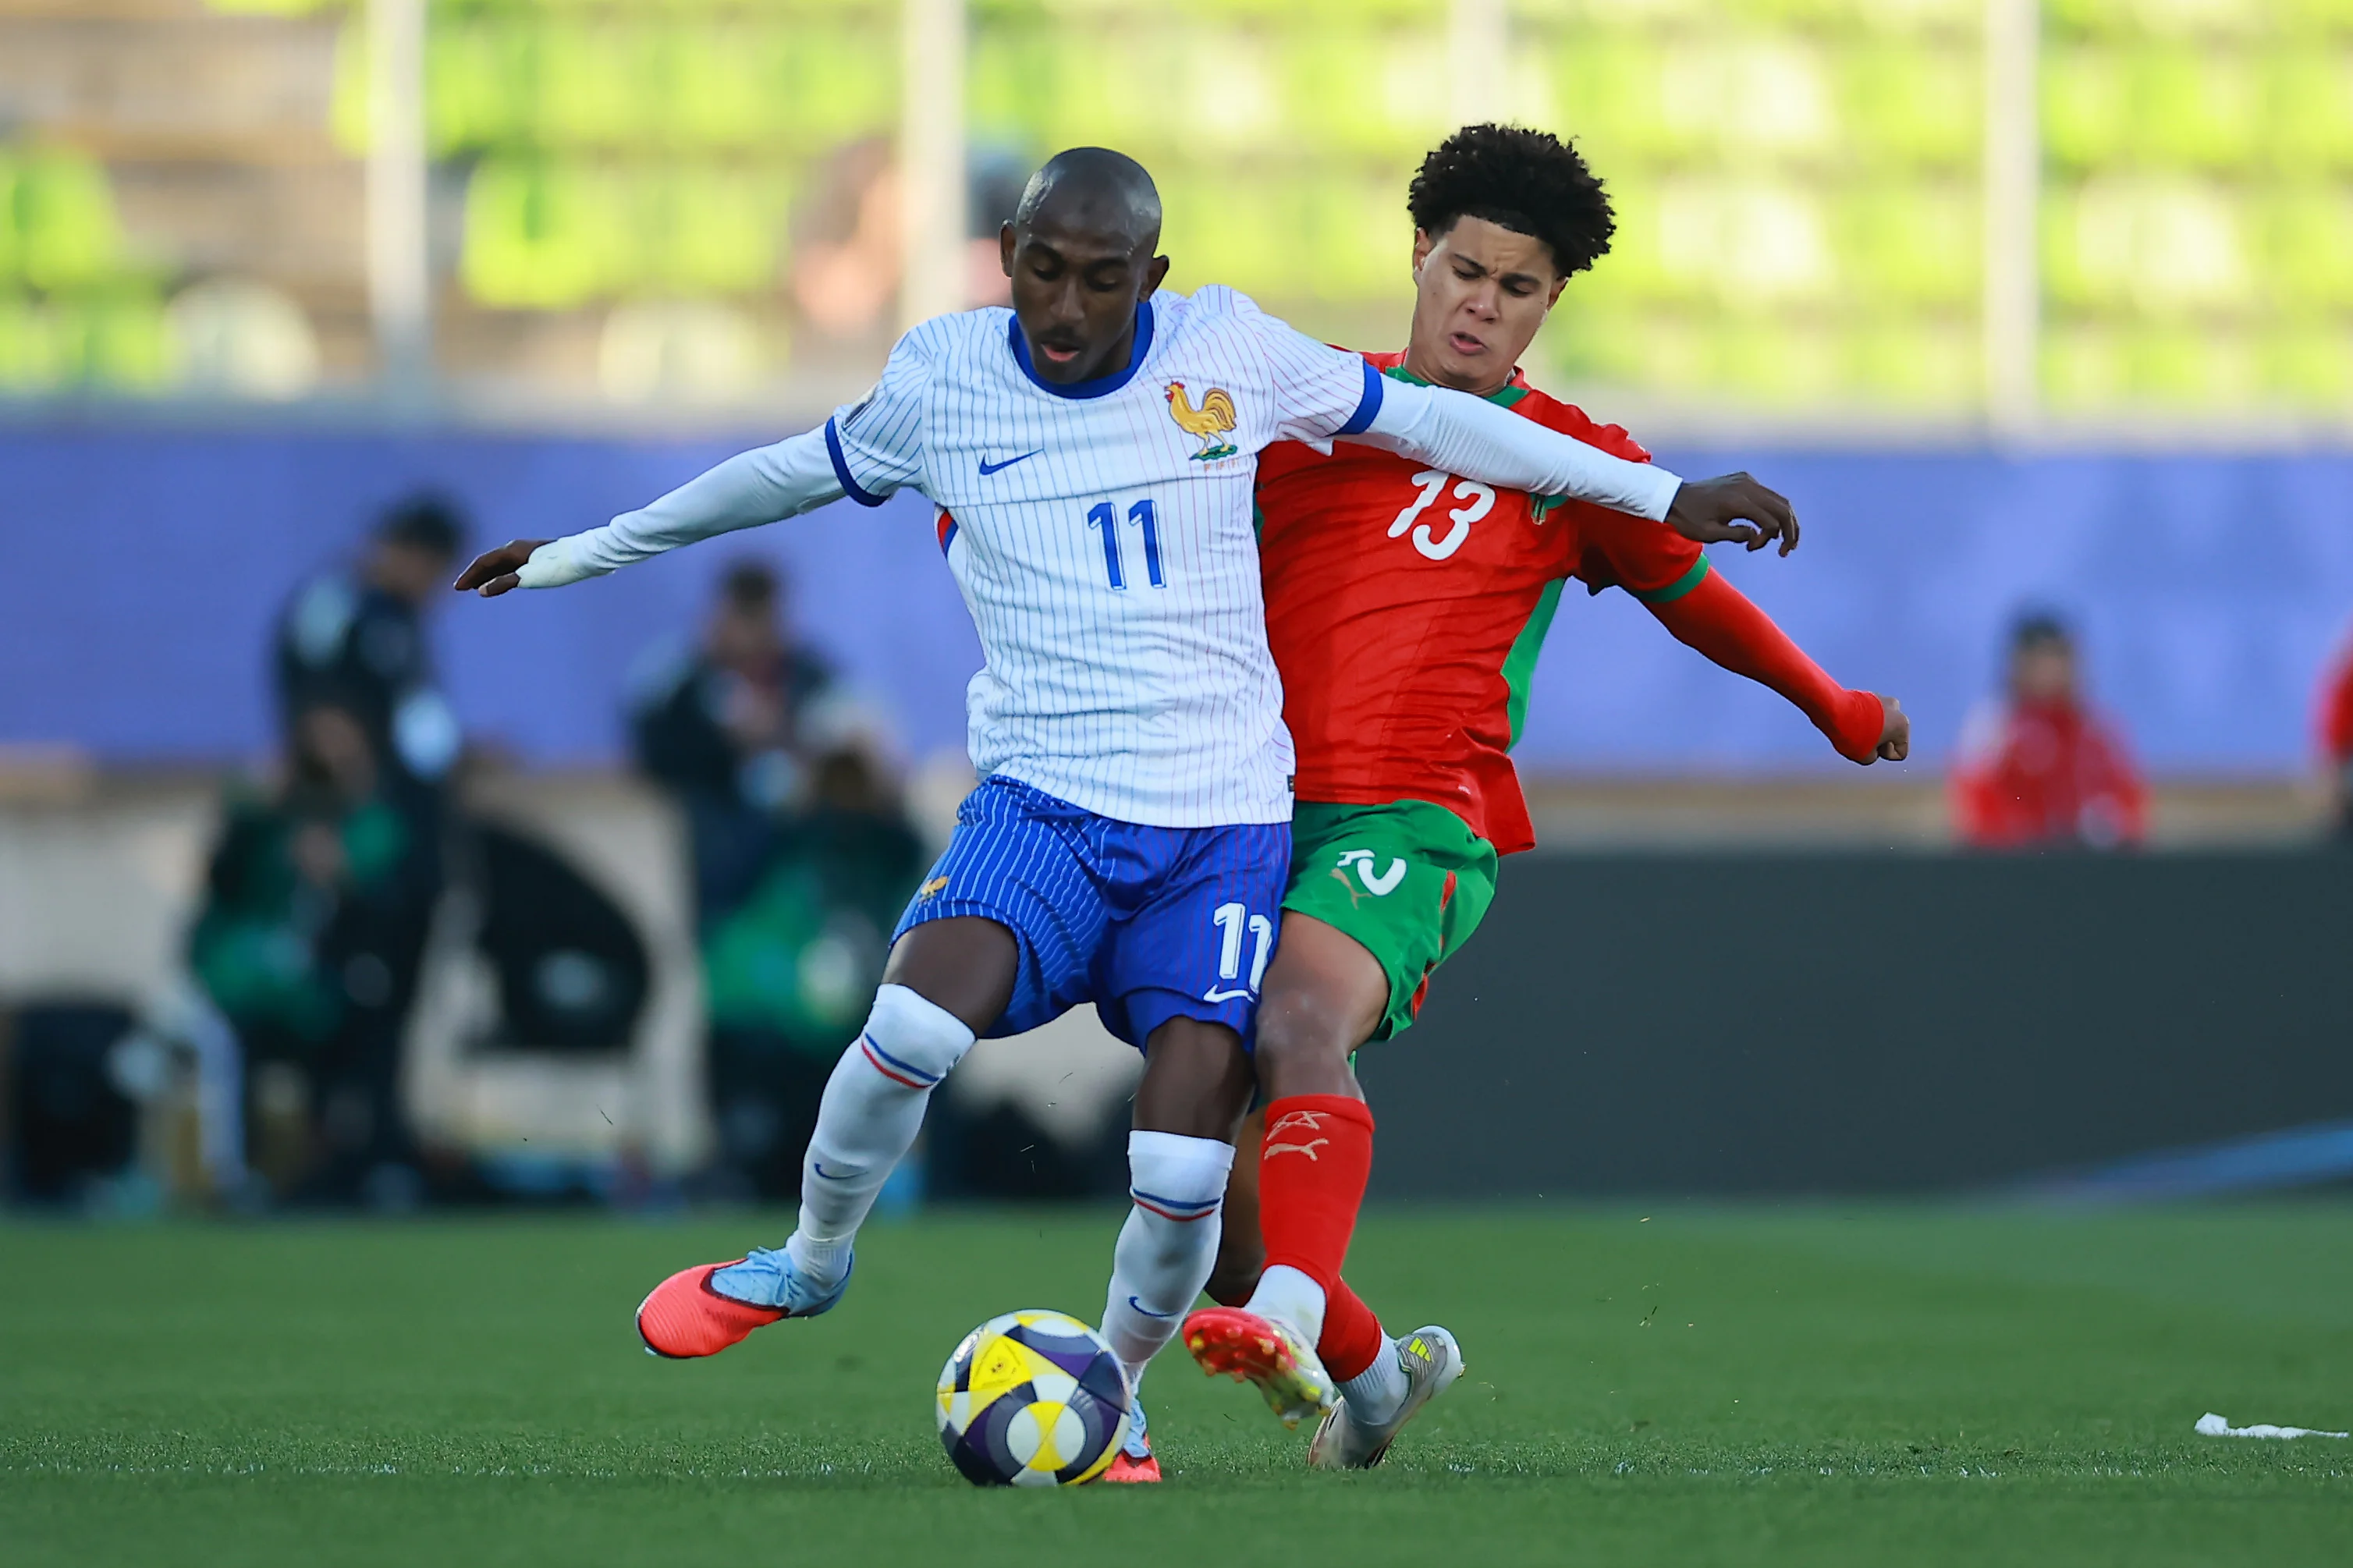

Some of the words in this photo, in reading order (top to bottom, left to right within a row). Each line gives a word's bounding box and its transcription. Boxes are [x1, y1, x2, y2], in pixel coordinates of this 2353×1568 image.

[1087, 499, 1167, 590] 11
[1387, 469, 1496, 560] 13
[1213, 902, 1273, 995] 11
